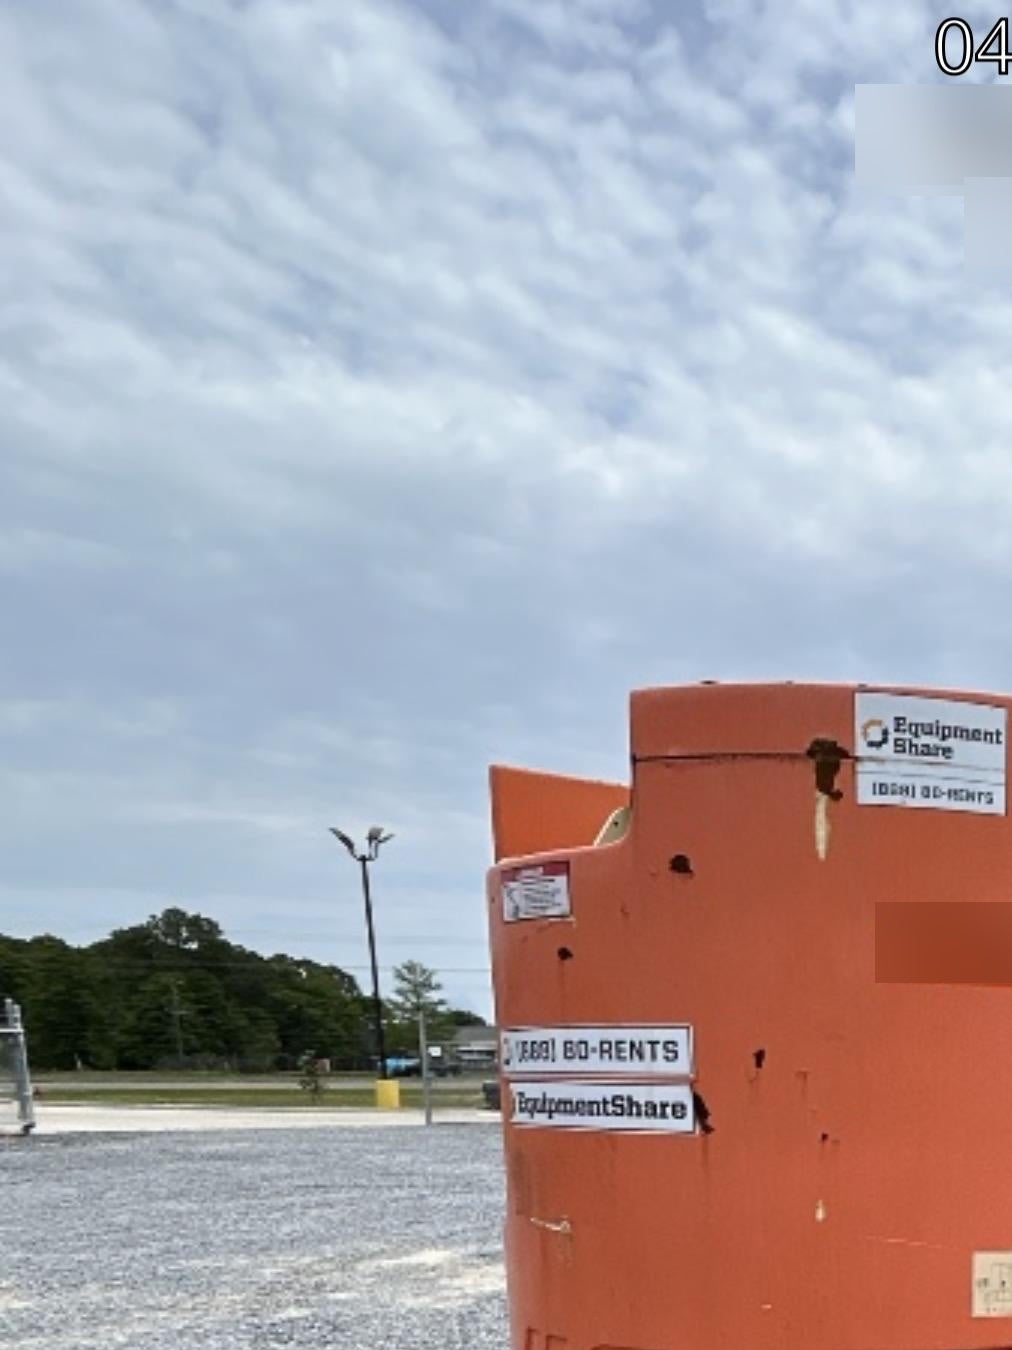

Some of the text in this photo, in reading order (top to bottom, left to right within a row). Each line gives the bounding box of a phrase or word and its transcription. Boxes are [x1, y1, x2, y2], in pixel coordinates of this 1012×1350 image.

[893, 716, 1003, 744] Equipment
[893, 737, 954, 760] Share
[515, 1090, 688, 1120] EquipmentShare
